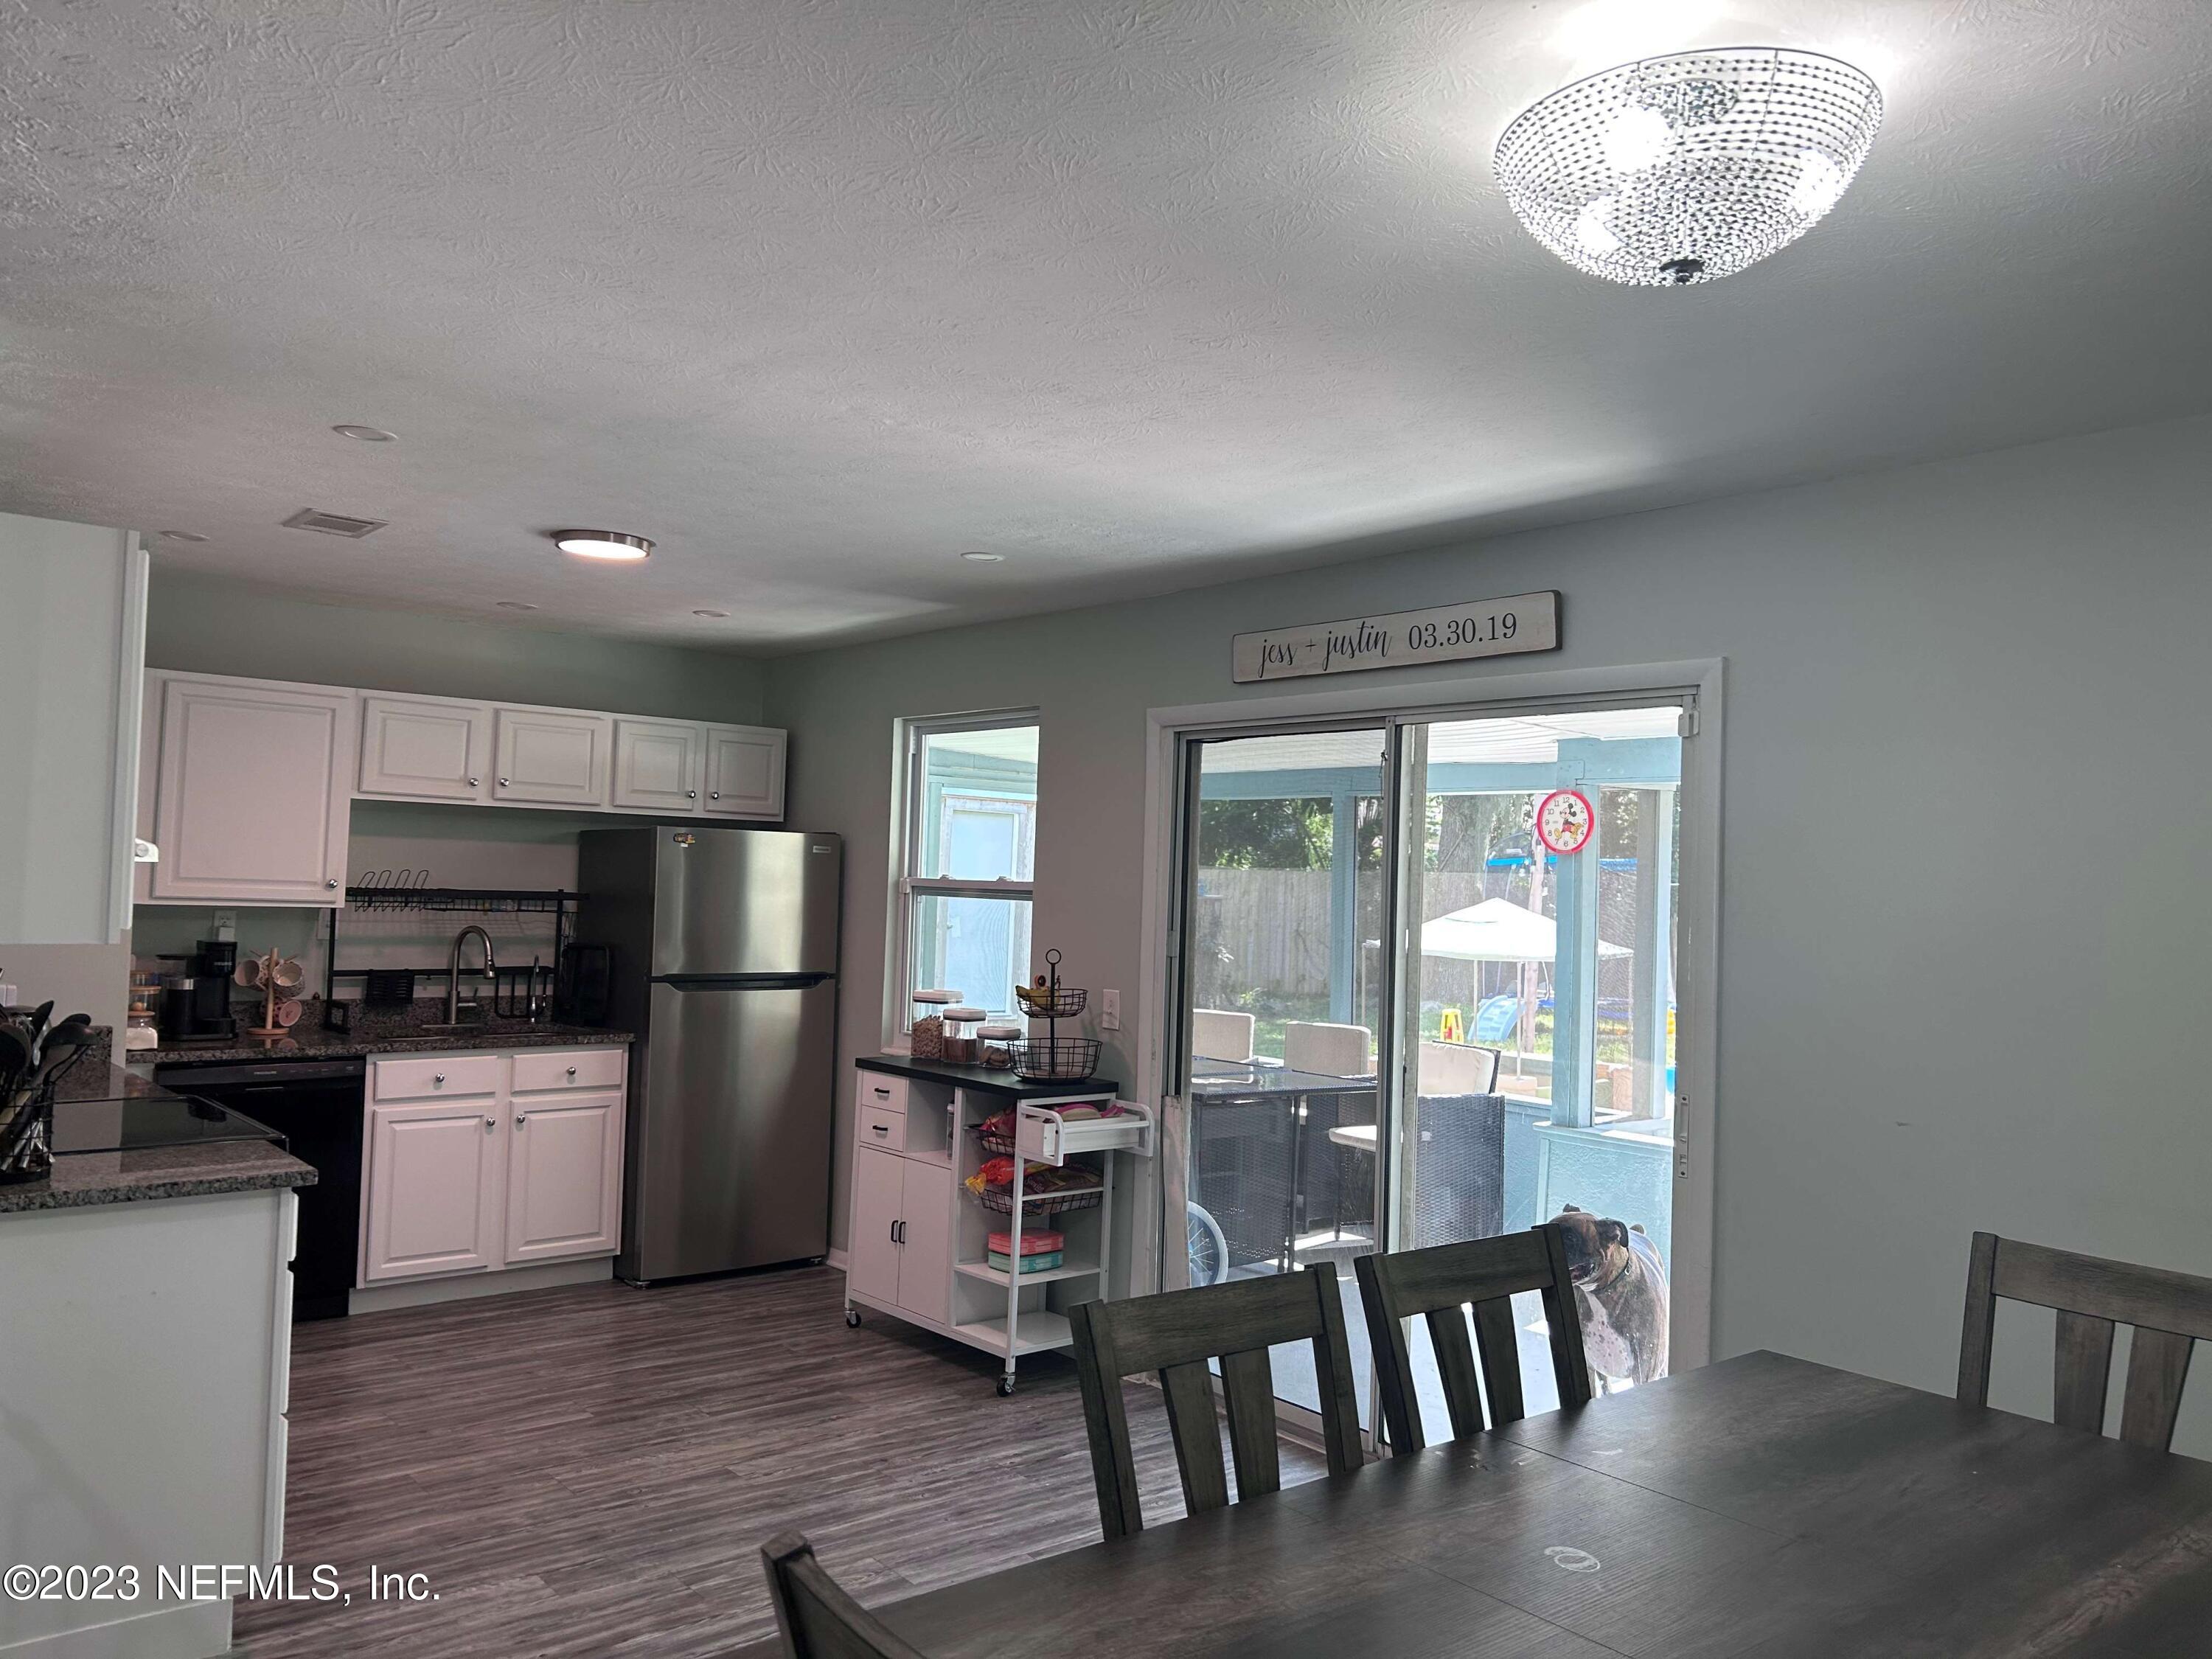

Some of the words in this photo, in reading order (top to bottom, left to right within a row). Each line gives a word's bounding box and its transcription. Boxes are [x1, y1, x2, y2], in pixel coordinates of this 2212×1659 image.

[1258, 639, 1297, 678] jess
[1322, 621, 1392, 672] justin
[1408, 613, 1517, 650] 03.30.19
